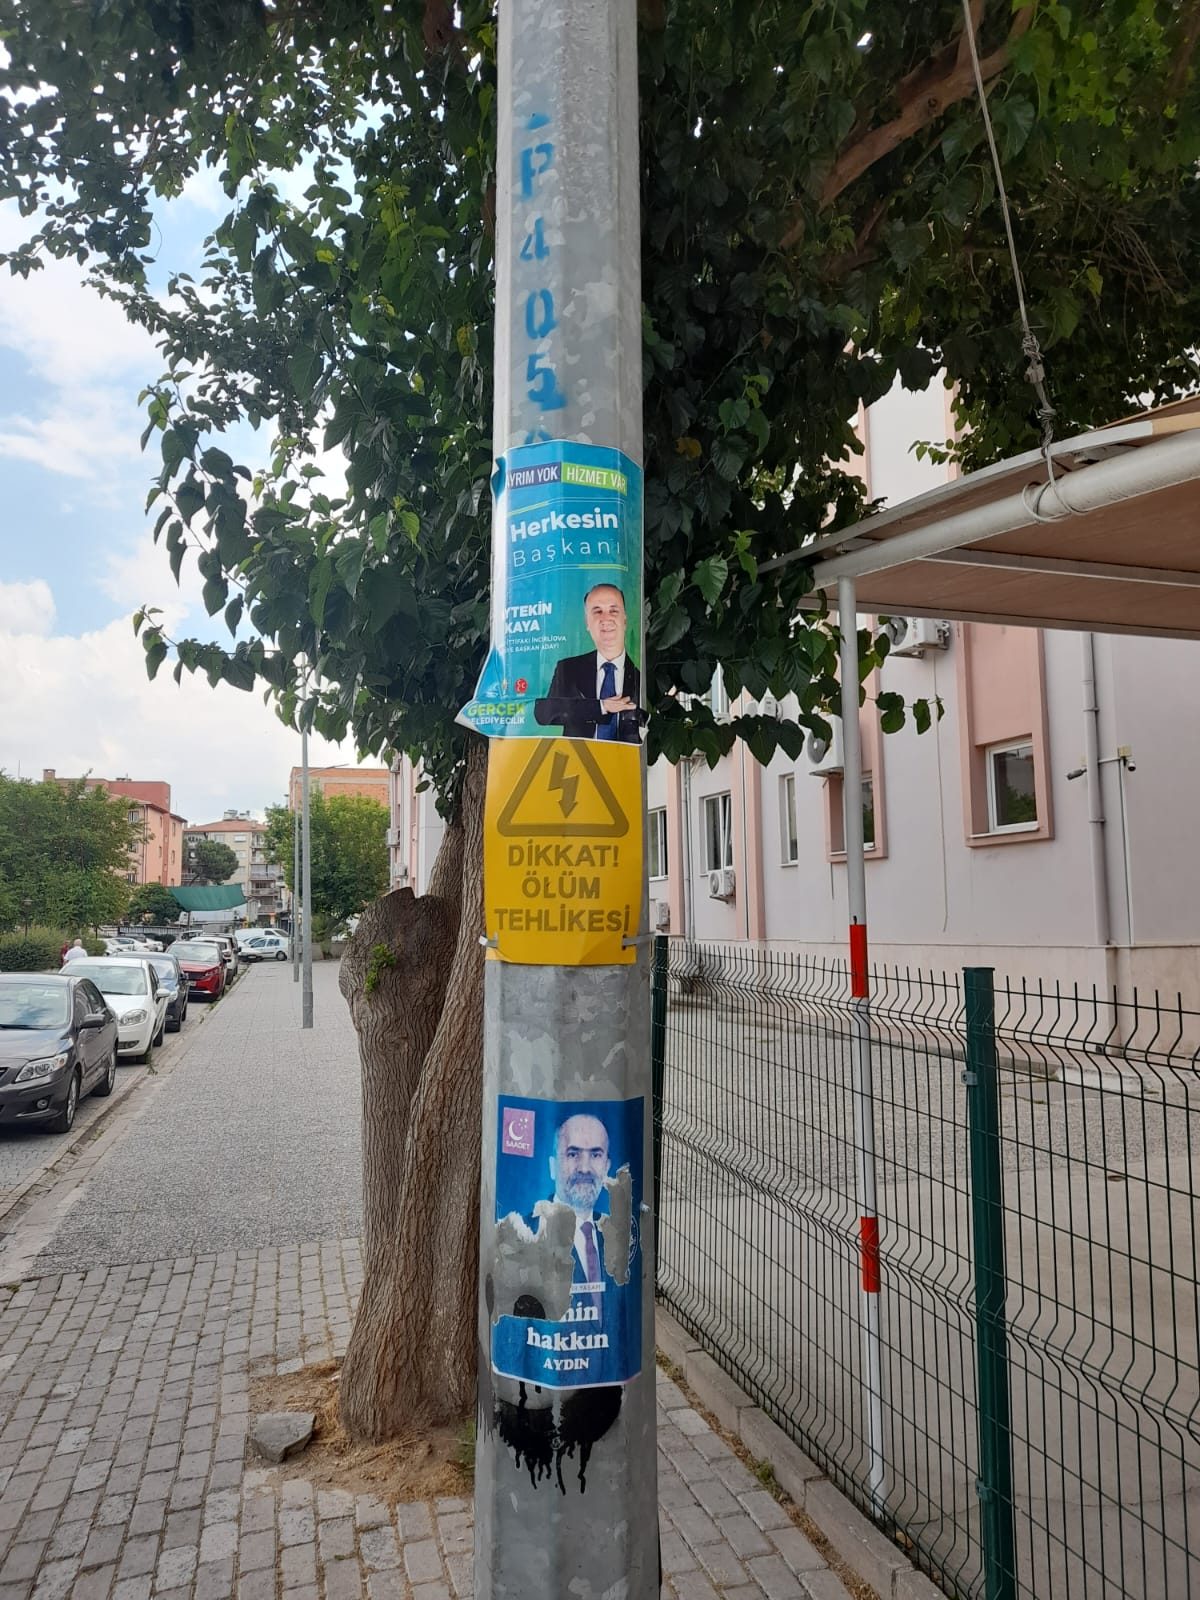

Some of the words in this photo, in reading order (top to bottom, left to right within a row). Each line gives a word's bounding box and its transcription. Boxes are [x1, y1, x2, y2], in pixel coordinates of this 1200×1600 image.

[520, 143, 565, 443] P405
[537, 466, 558, 483] YOK
[566, 465, 608, 485] HİZMET
[511, 508, 618, 542] Herkesin
[513, 539, 620, 567] Başkanı
[508, 840, 619, 867] DİKKAT!
[522, 871, 600, 899] ÖLÜM
[495, 904, 630, 932] TEHLİKESİ
[526, 1326, 610, 1352] hakkın
[543, 1357, 589, 1371] AYDIN
